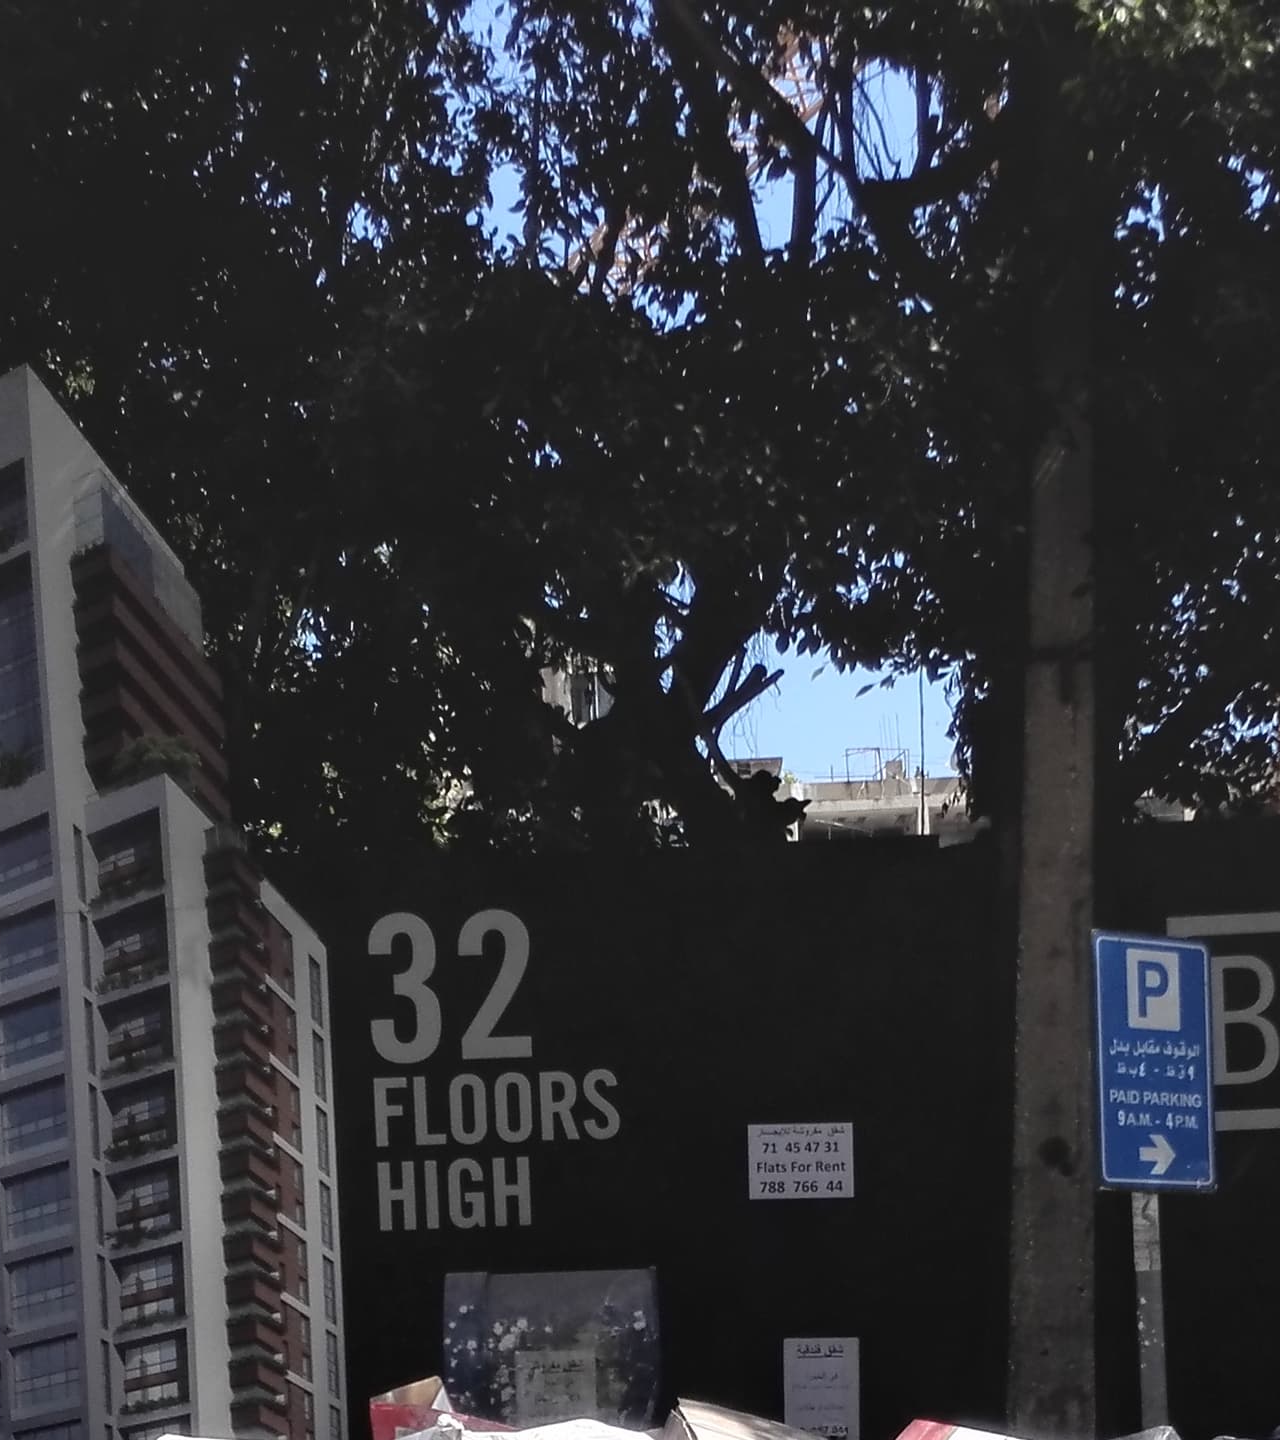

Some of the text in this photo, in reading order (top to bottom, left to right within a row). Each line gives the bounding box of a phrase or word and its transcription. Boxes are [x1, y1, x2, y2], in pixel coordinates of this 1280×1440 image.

[368, 909, 532, 1064] 32
[1136, 960, 1169, 1018] P
[1109, 1037, 1200, 1061] الوقوف مقابل بدل
[373, 1069, 620, 1147] FLOORS
[1109, 1089, 1202, 1108] PAID PARKING
[762, 1141, 839, 1154] 71 45 47 31
[756, 1161, 846, 1173] Flats For Rent
[377, 1156, 532, 1231] HIGH
[760, 1180, 843, 1193] 788 766 44
